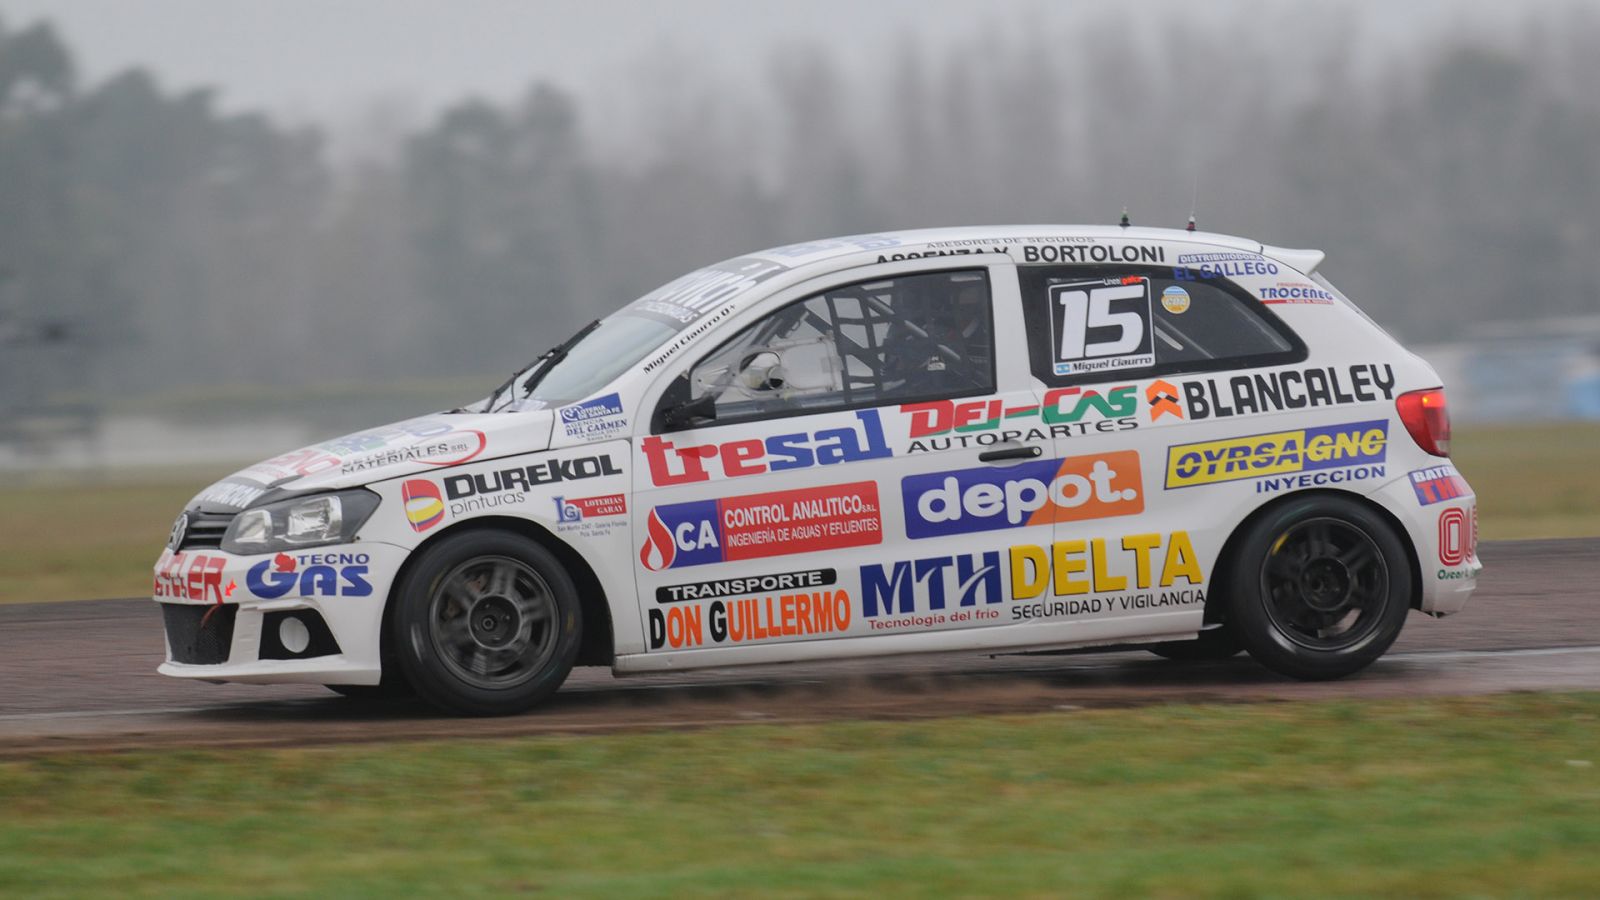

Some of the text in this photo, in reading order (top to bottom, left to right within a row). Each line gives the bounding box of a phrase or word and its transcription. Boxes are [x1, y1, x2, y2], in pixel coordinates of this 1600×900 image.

[926, 235, 1096, 249] ASESORES DE SEGUROS
[1024, 245, 1165, 263] BORTOLONI
[1173, 262, 1279, 281] EL GALLEGO
[1059, 284, 1145, 360] 15
[643, 343, 681, 374] Miguel
[680, 316, 721, 346] Ciaurro
[1071, 355, 1153, 374] Miguel Ciaurro
[1182, 364, 1396, 420] BLANCALEY
[565, 418, 604, 429] AGENCIA
[566, 427, 586, 436] DEL
[587, 419, 627, 433] CARMEN
[906, 417, 1139, 454] AUTOPARTES
[342, 443, 448, 475] MATERIALES
[641, 408, 893, 487] tresal
[443, 454, 623, 501] DUREKOL
[917, 459, 1138, 524] depot.
[1256, 465, 1386, 494] INYECCION
[450, 491, 526, 518] pinturas
[584, 497, 623, 507] LOTERIAS
[597, 505, 624, 514] GARAY
[724, 502, 790, 529] CONTROL
[792, 494, 862, 520] ANALITICO
[675, 519, 719, 553] CA
[727, 518, 879, 549] INGENIERÍA DE AGUAS Y EFLUENTES
[297, 553, 370, 565] TECNO
[1008, 530, 1204, 601] DELTA
[246, 559, 373, 599] GAS
[668, 571, 823, 601] TRANSPORTE
[860, 551, 1003, 618] MTH
[648, 589, 851, 650] DON GUILLERMO
[868, 606, 999, 631] Tecnologia del frio
[1011, 588, 1206, 620] SEGURIDAD Y VIGILANCIA
